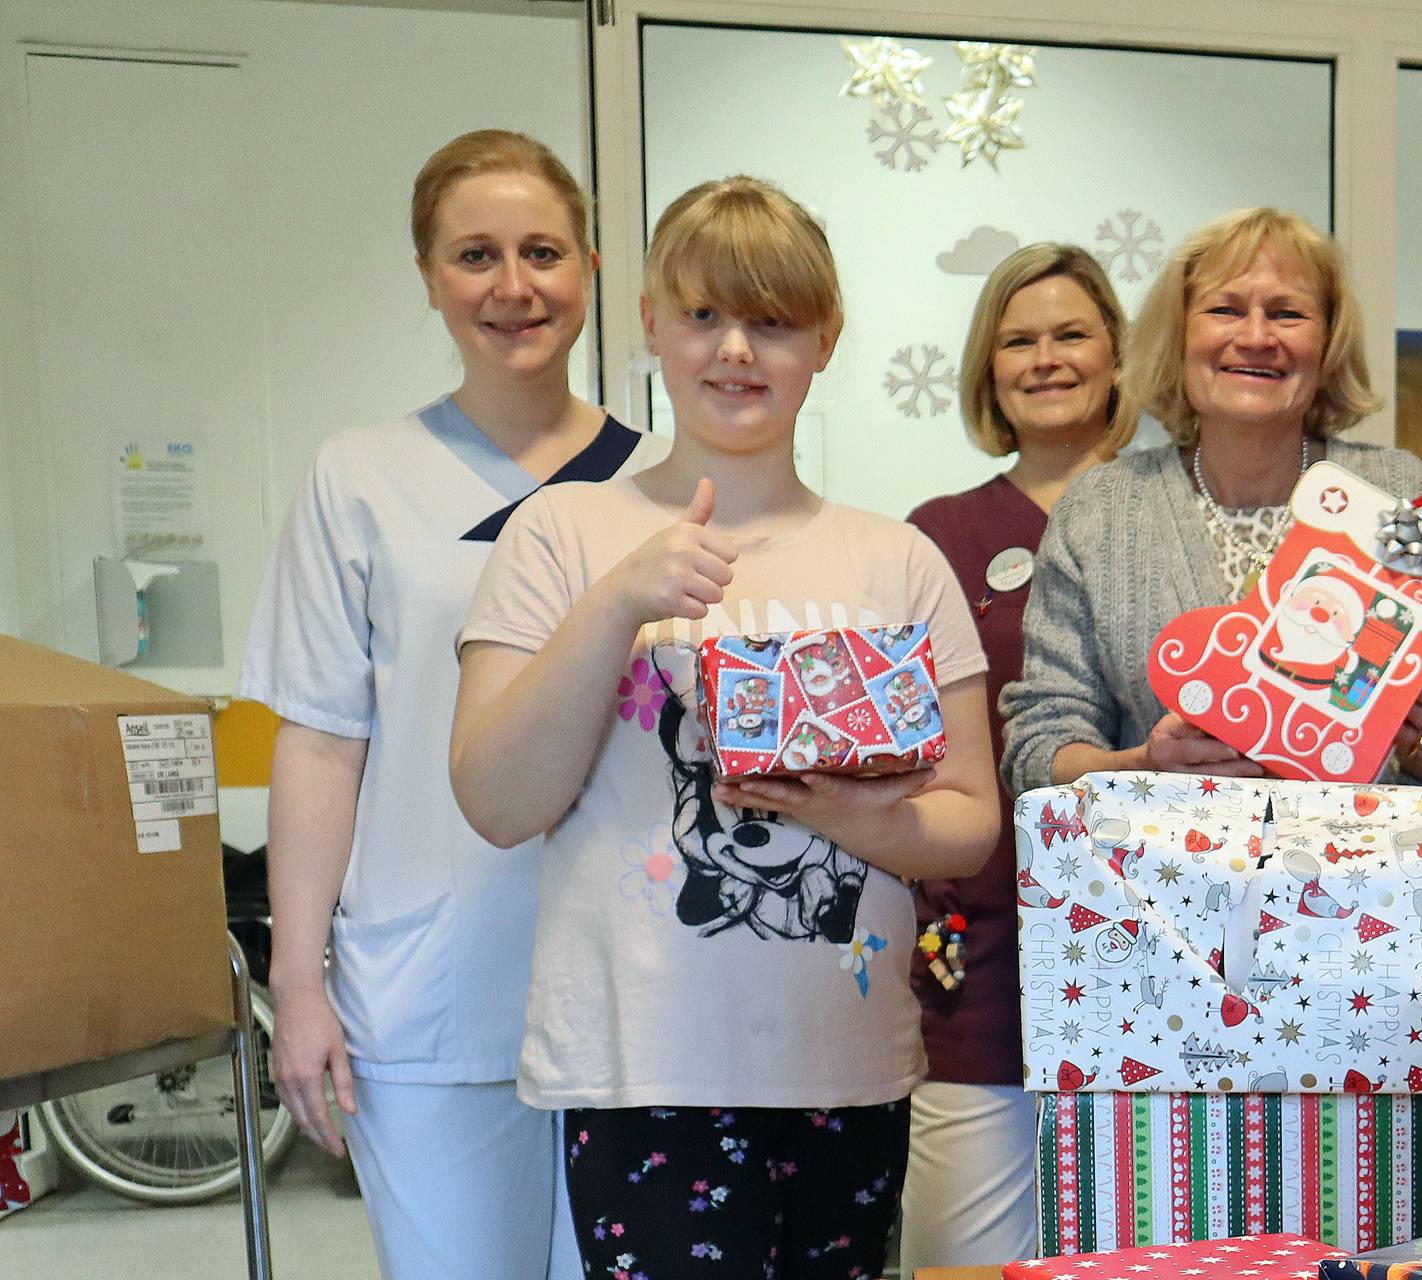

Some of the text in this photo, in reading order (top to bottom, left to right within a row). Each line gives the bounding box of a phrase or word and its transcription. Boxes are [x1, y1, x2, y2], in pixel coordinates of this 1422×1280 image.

[1029, 923, 1056, 1056] CHRISTMAS
[1315, 932, 1342, 1066] CHRISTMAS
[1373, 963, 1401, 1047] HAPPY
